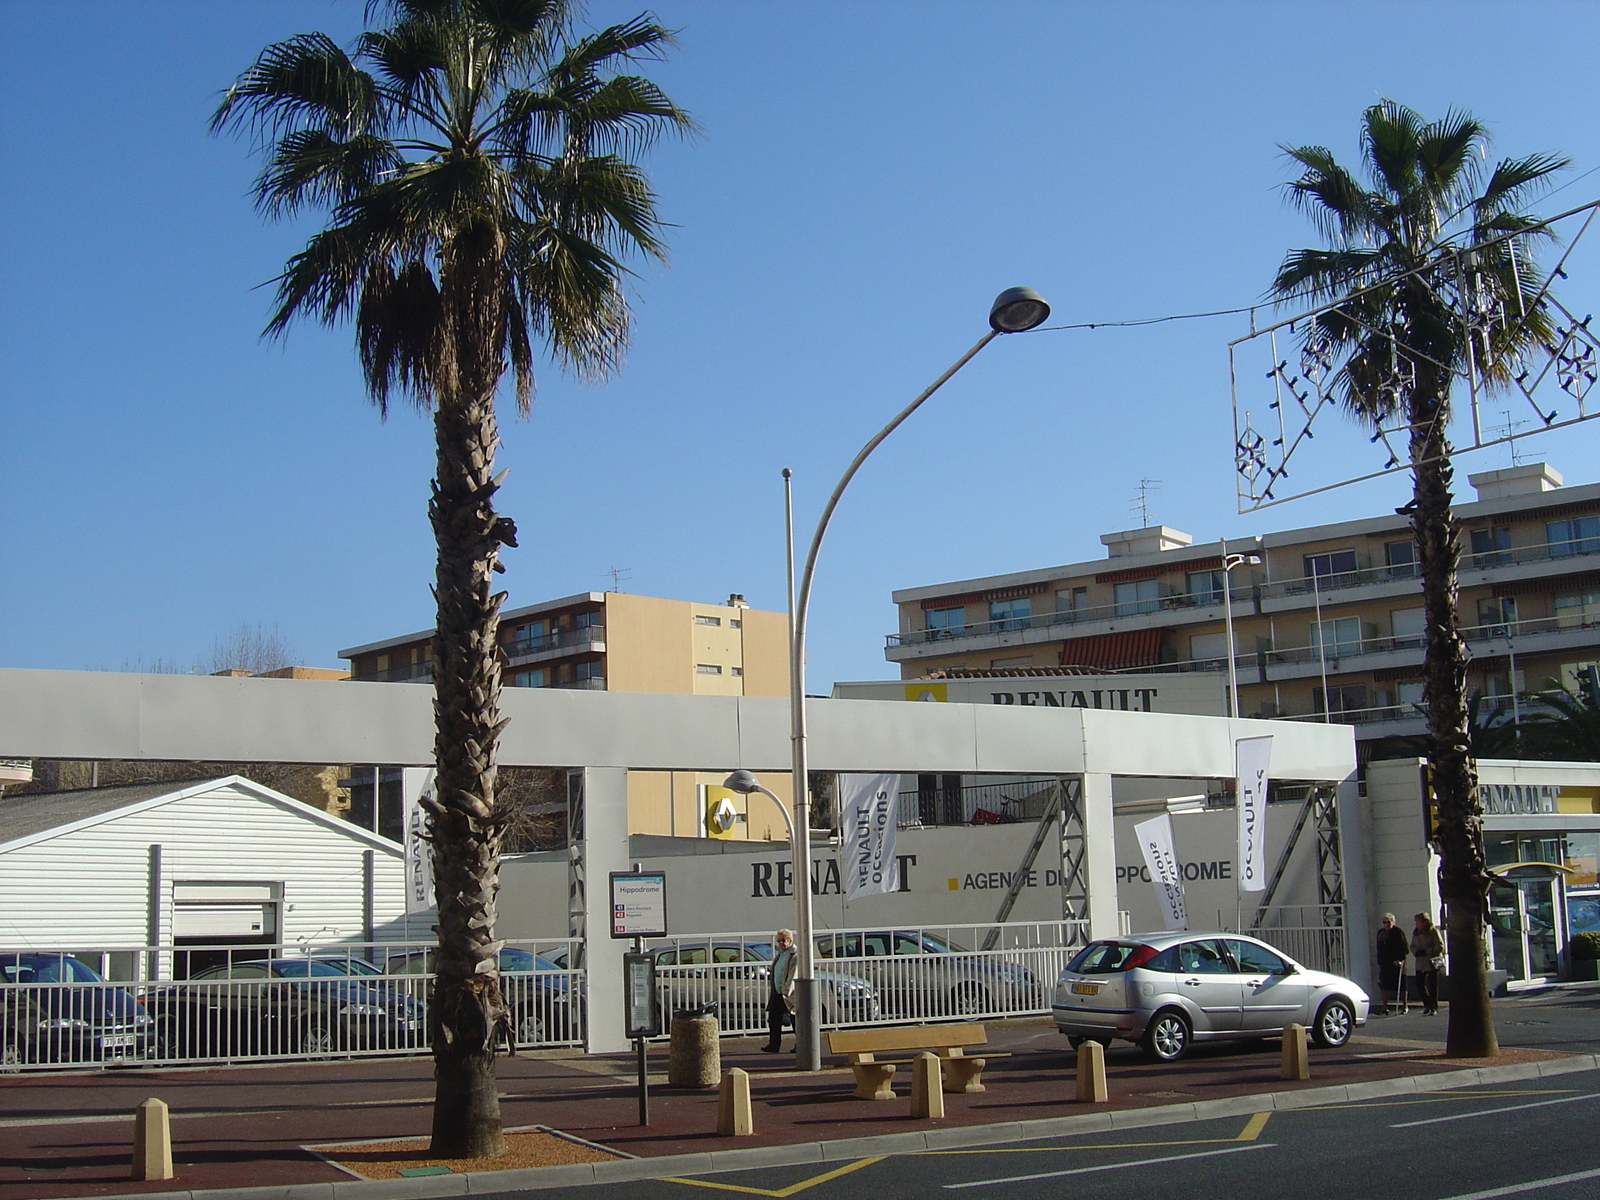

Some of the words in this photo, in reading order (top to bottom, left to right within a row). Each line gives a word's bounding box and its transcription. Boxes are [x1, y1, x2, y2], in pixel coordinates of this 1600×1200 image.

[1479, 784, 1561, 814] ENAULT
[411, 808, 425, 902] RENAULT
[620, 886, 660, 894] Hippodrome
[751, 855, 917, 897] RENAT
